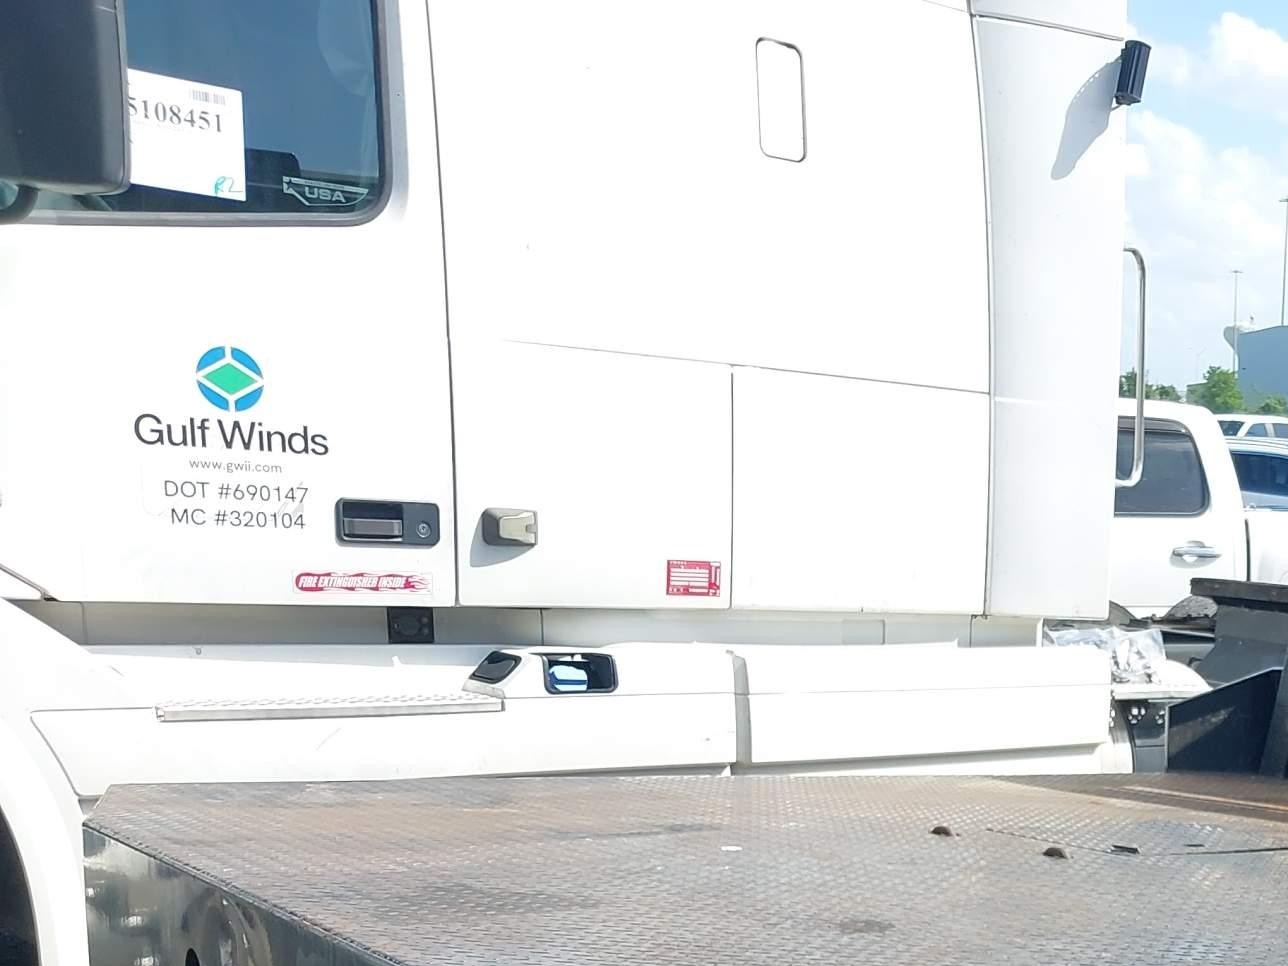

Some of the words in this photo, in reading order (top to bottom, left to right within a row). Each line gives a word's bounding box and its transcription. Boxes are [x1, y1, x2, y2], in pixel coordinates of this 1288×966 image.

[305, 186, 347, 203] USA
[134, 414, 210, 448] Gulf
[217, 417, 329, 456] Winds
[188, 459, 283, 474] www.gwii.com
[164, 480, 210, 499] DOT
[218, 483, 309, 503] #690147
[171, 508, 207, 526] MC
[214, 510, 306, 529] #320104
[298, 575, 318, 588] FIRE
[318, 575, 378, 589] EXTINGUISHER
[378, 576, 406, 589] INSIDE
